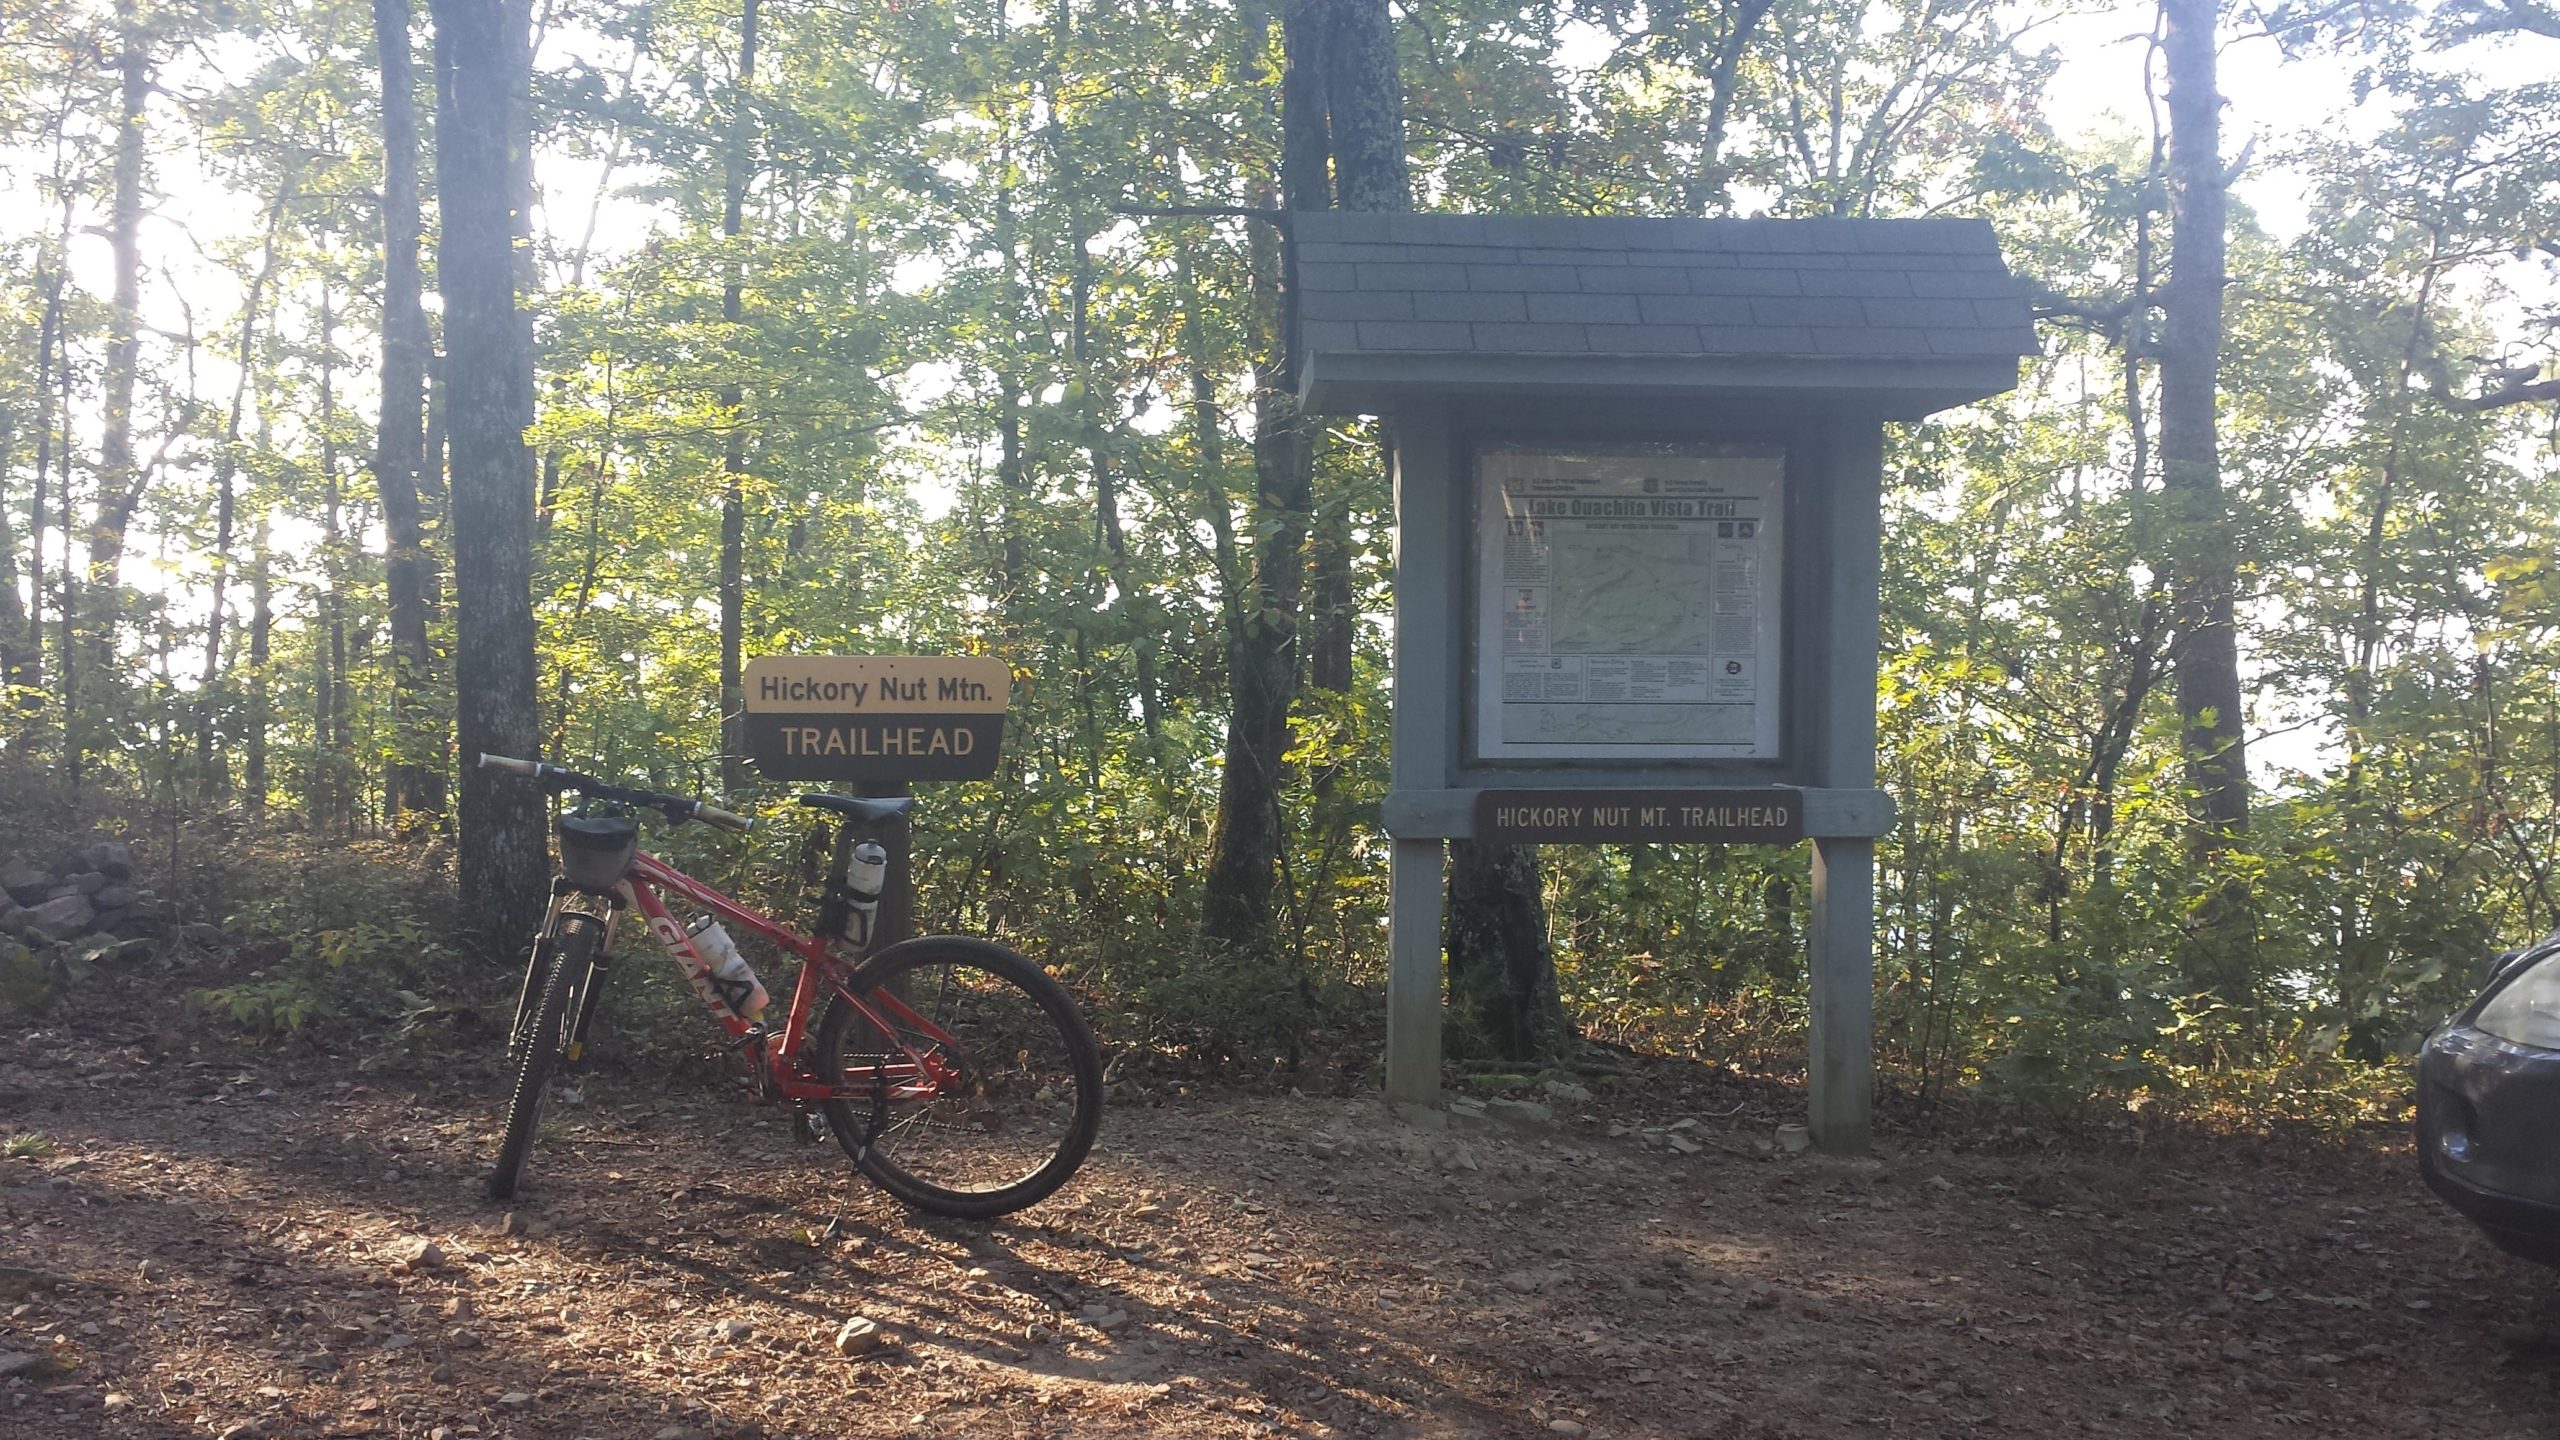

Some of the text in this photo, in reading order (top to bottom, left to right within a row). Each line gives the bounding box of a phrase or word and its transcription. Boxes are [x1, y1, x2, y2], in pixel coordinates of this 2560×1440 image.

[1529, 499, 1736, 517] Lake Ouachita Vista Trail
[761, 676, 992, 707] Hickory Nut Mtn.
[781, 727, 974, 756] TRAILHEAD
[1497, 807, 1788, 827] HICKORY NUT MT. TRAILHEAD
[651, 917, 739, 1022] GIANT
